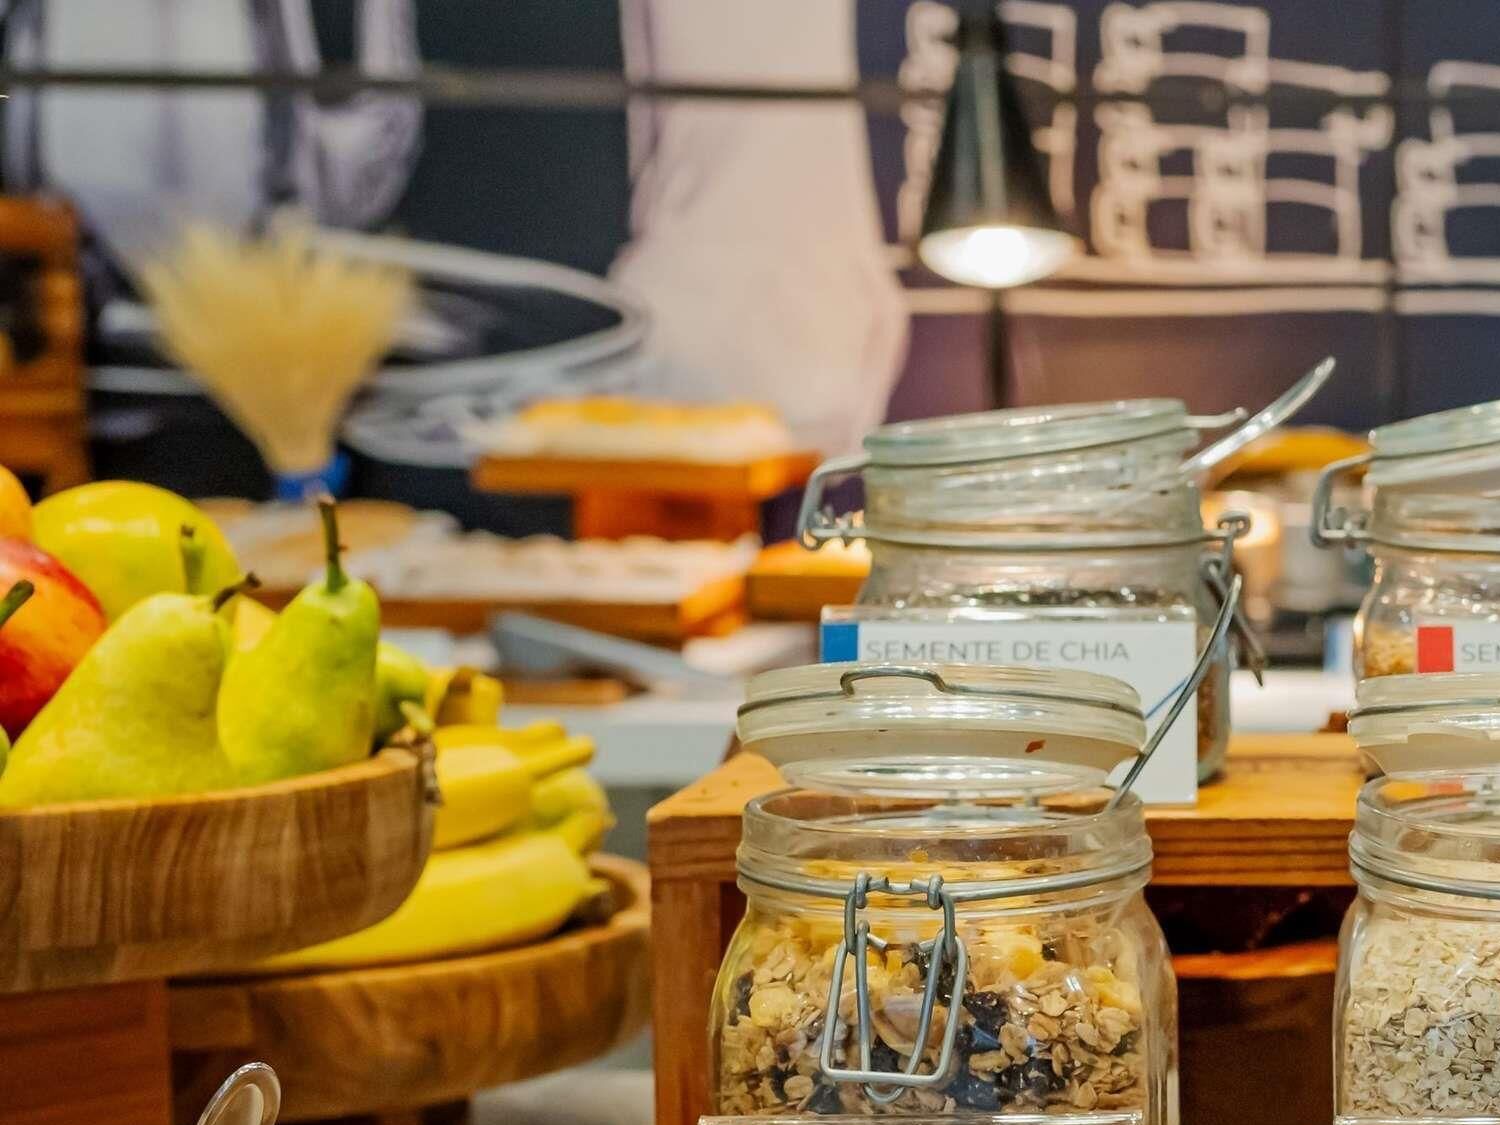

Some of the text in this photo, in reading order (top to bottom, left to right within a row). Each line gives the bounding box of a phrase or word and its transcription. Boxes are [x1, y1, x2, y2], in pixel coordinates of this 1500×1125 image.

[865, 641, 1131, 662] SEMENTE DE CHIA
